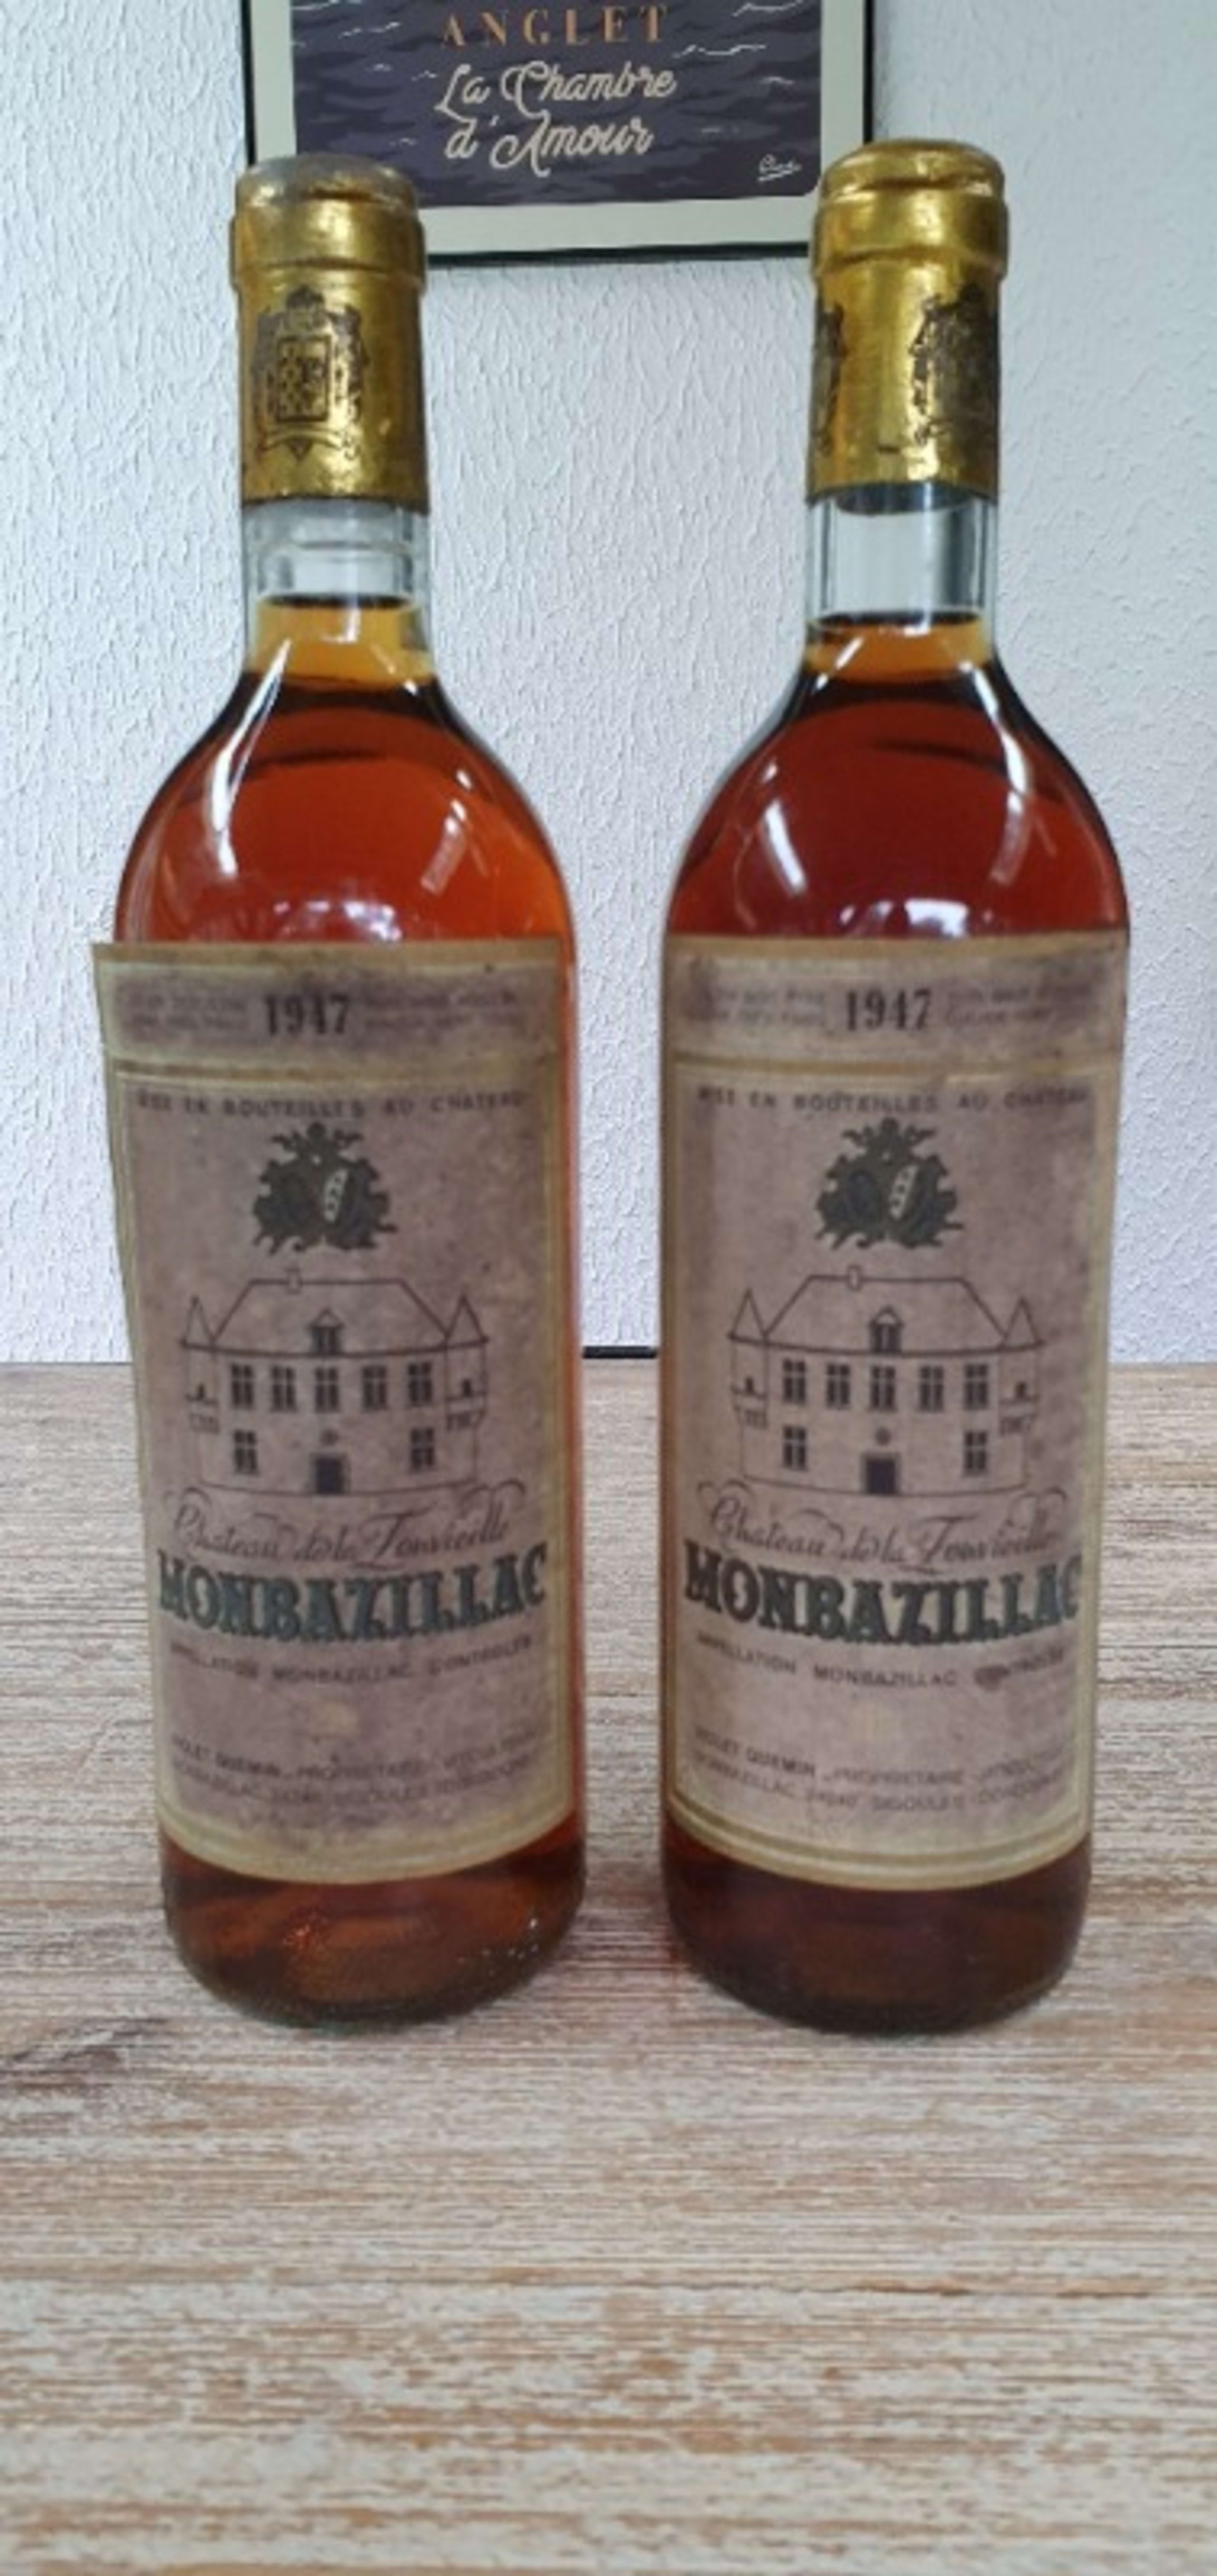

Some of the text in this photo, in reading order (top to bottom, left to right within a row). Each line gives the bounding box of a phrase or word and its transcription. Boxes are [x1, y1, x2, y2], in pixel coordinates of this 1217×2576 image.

[442, 6, 666, 46] ANGLET
[435, 61, 677, 122] La Chambre
[445, 110, 654, 177] d'Amour
[265, 993, 350, 1036] 1947
[845, 988, 932, 1032] 1947
[158, 1542, 548, 1642] MONBAZILLAC
[684, 1539, 1083, 1646] MONBAZILLAC
